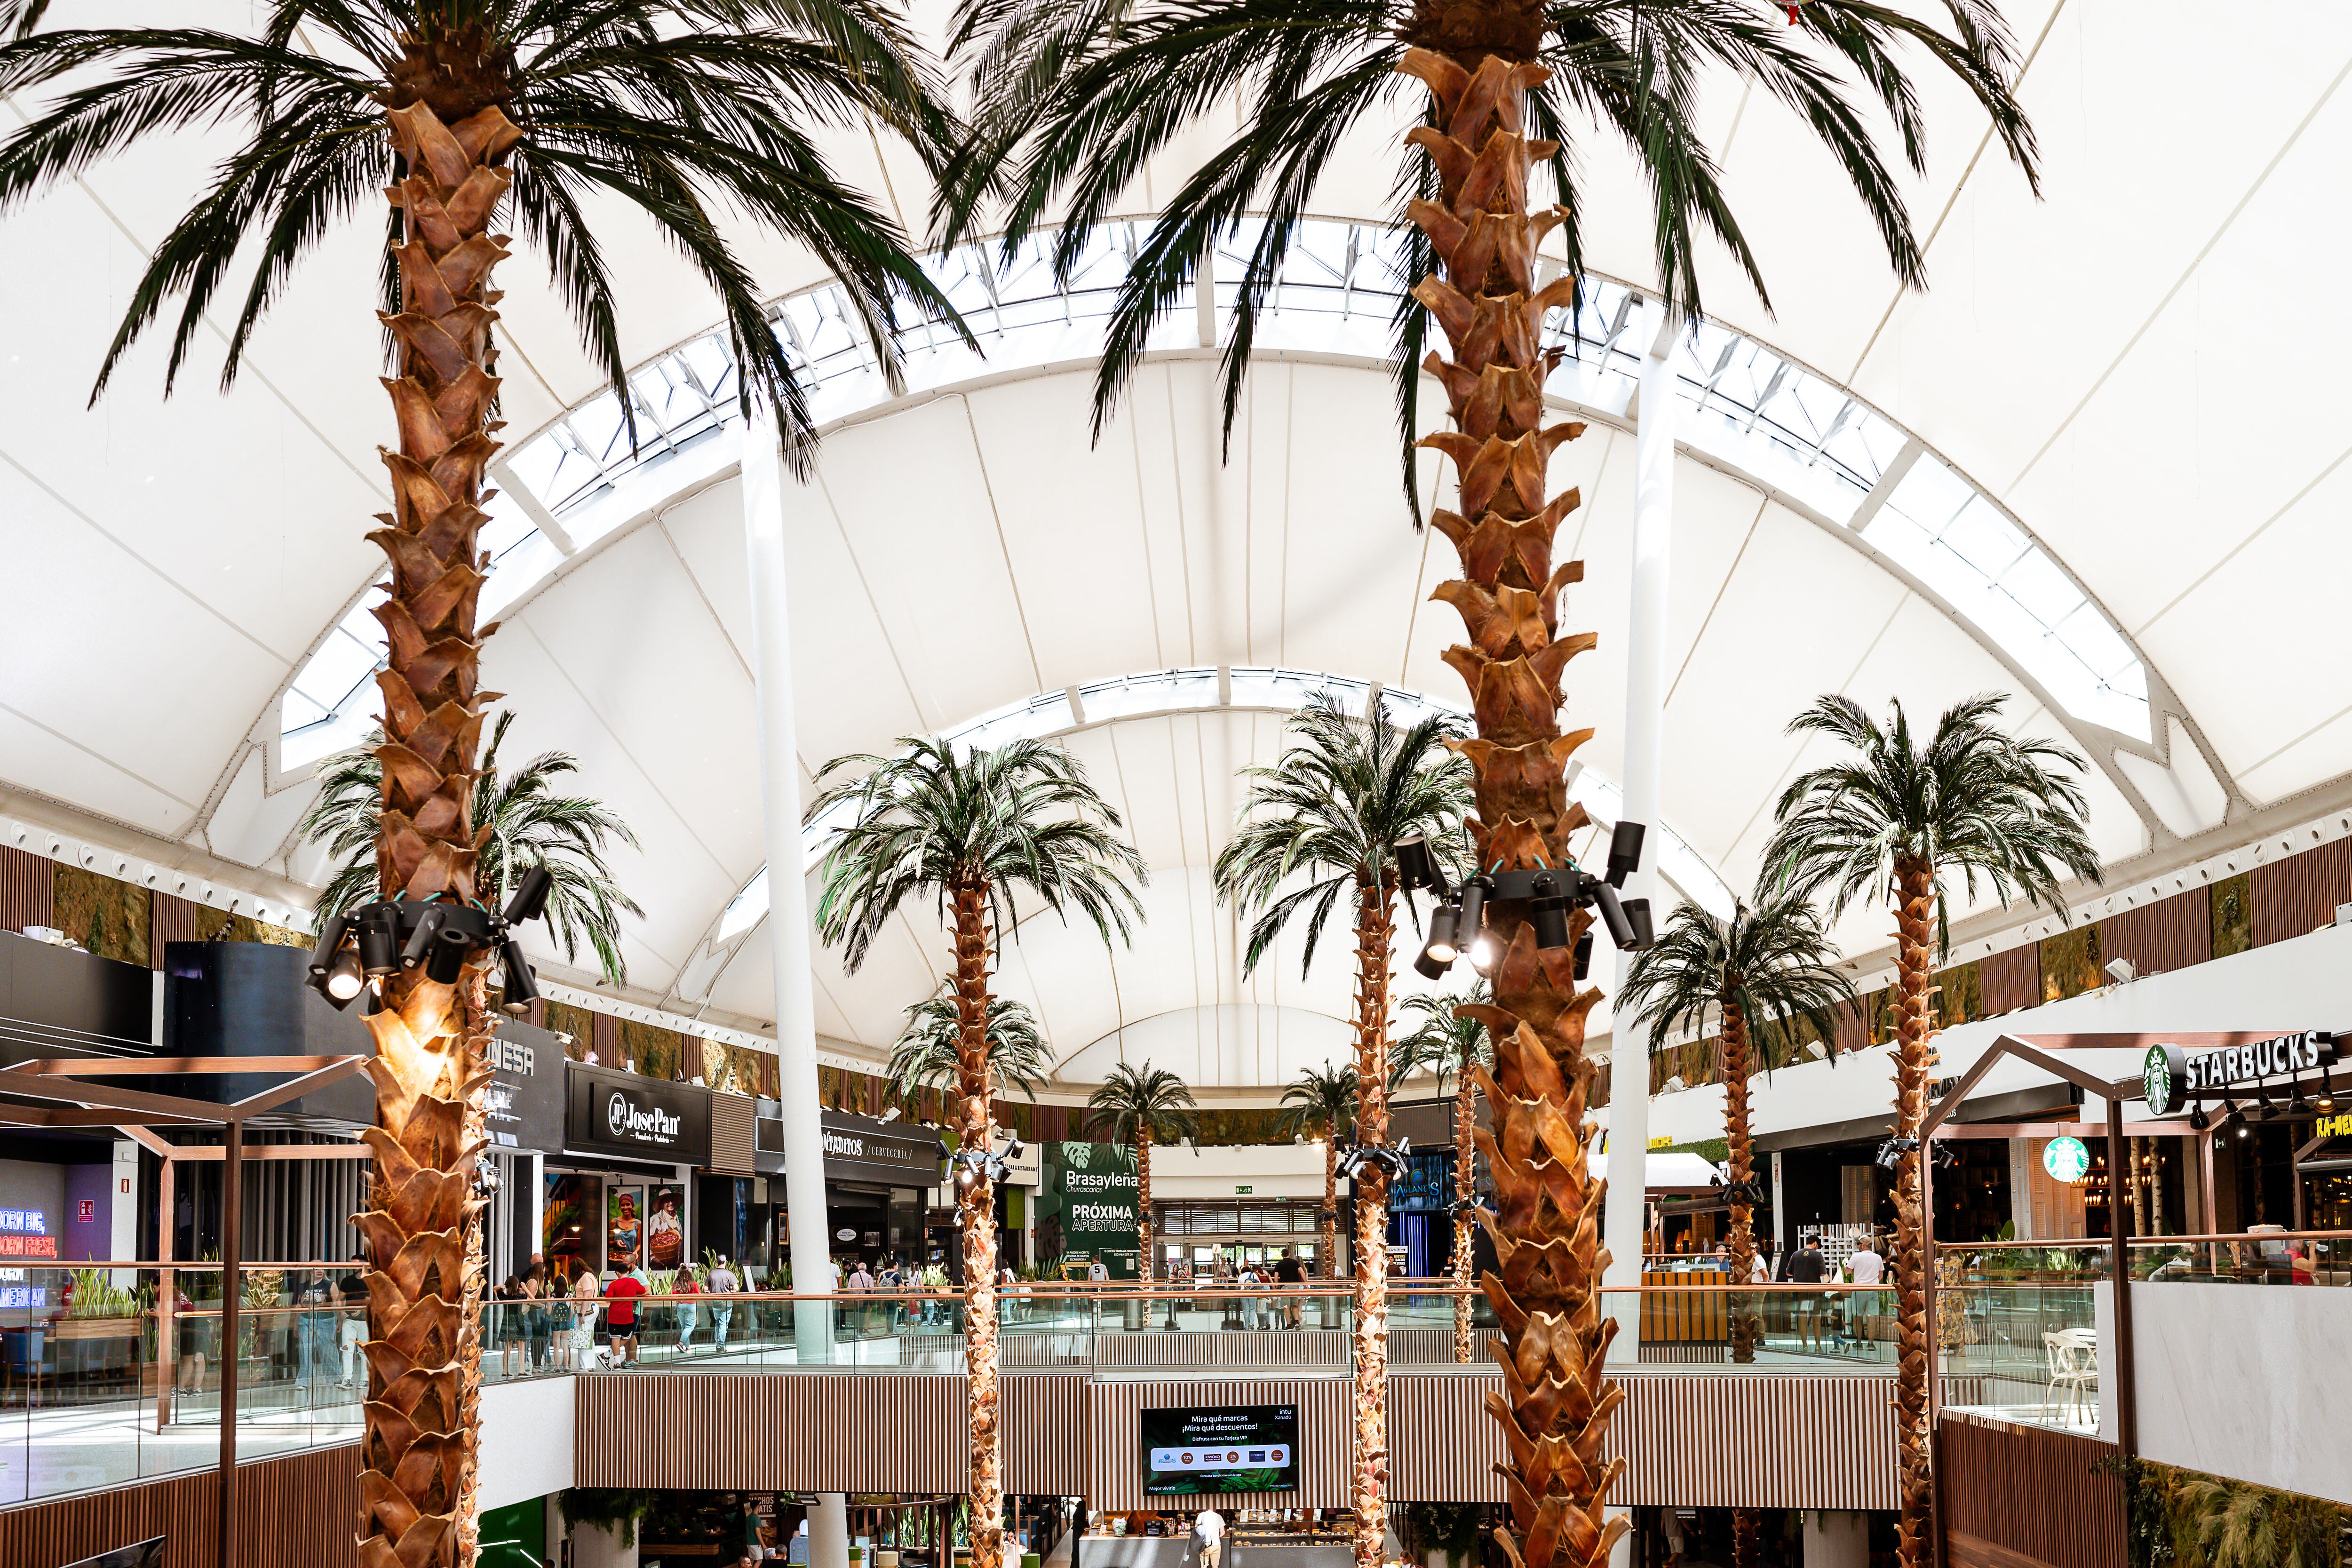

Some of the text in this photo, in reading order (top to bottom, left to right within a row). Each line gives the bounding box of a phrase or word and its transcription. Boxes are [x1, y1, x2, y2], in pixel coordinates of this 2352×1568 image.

[487, 1037, 534, 1076] INESA
[2185, 1030, 2318, 1090] STARBUCKS
[626, 1103, 680, 1135] JosePan
[822, 1130, 863, 1156] NTADITOS
[1066, 1170, 1138, 1189] Brasayleña
[1073, 1201, 1133, 1219] PRÓXIMA
[25, 1212, 45, 1234] BIG,
[1072, 1219, 1134, 1232] APERTURA
[25, 1236, 57, 1259] FRESH,
[0, 1268, 24, 1281] ORN
[1094, 1266, 1100, 1274] 5
[1201, 1424, 1215, 1433] qué
[1208, 1415, 1222, 1424] qué
[758, 1504, 772, 1513] ATIS
